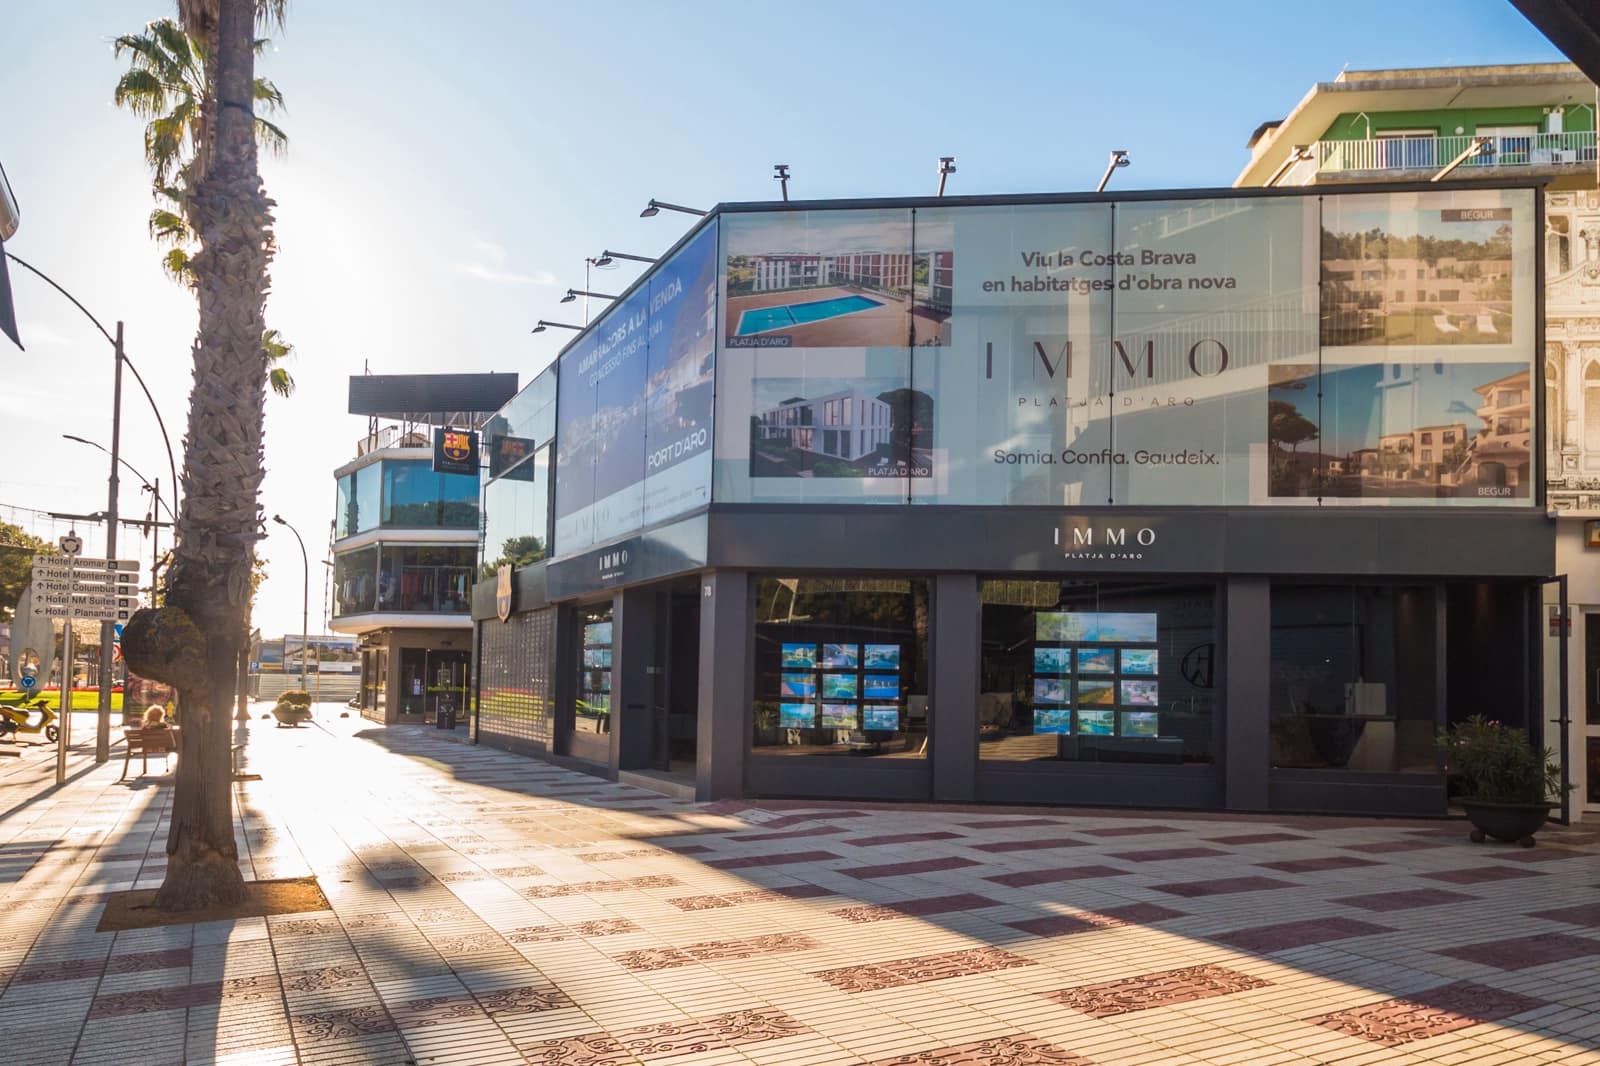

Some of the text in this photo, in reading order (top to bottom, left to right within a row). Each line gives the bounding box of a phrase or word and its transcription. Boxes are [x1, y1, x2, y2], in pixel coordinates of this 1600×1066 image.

[1460, 209, 1493, 219] BEGUR
[1021, 249, 1196, 267] Viu la Costa Brava
[982, 274, 1236, 296] en habitatges d'obra nova
[649, 276, 683, 316] VENDA
[730, 337, 789, 346] PLATJA D'ARO
[985, 339, 1229, 379] IMMO
[1018, 396, 1194, 407] PLATJA D'ARO
[647, 427, 707, 471] PORT D'ARO
[994, 448, 1220, 465] Somia. Confia. Gaudeix.
[867, 467, 899, 476] PLATJA
[1477, 486, 1511, 496] BEGUR
[1054, 527, 1155, 545] IMMO
[47, 556, 105, 568] Hotel Aromar
[599, 549, 628, 571] IMMO
[46, 569, 117, 581] Hotel Monterrey
[46, 582, 116, 593] Hotel Columbus
[45, 595, 116, 606] Hotel NM Suites
[45, 607, 115, 618] Hotel Planamar
